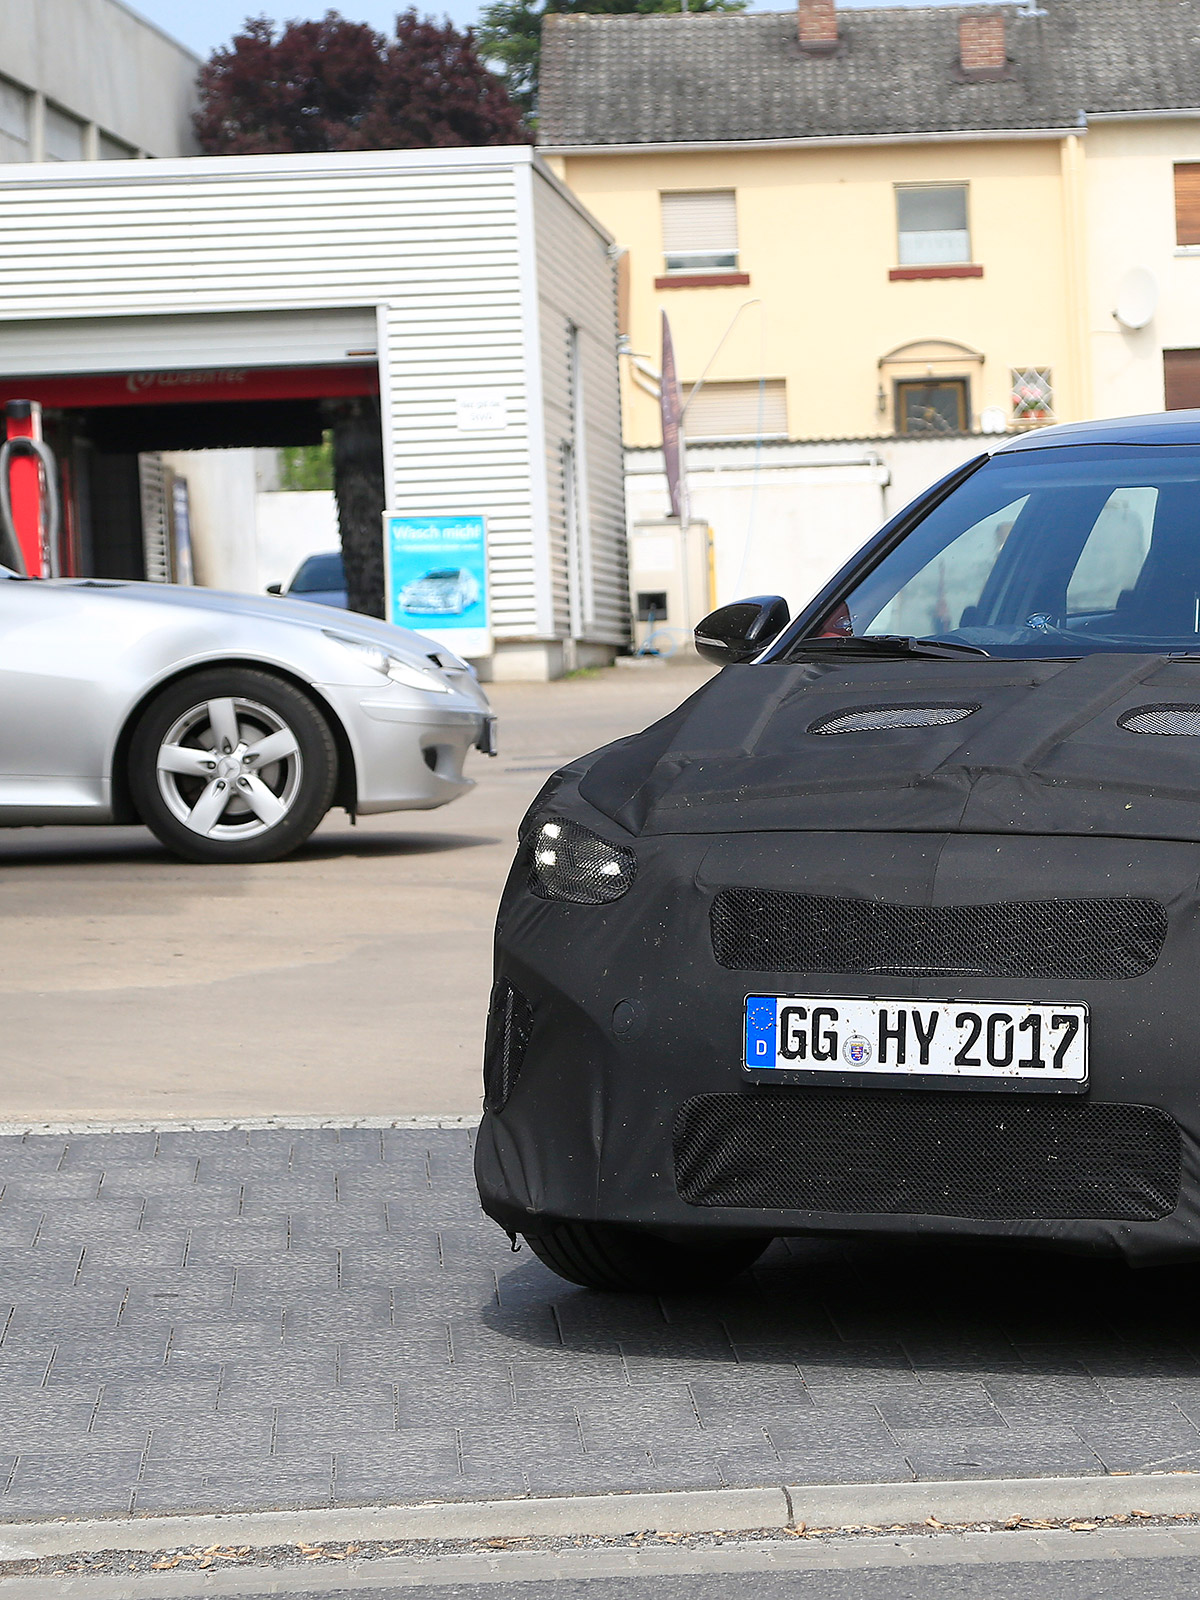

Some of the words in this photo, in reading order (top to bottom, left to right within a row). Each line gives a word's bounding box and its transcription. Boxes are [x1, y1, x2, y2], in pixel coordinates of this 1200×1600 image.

[392, 525, 440, 540] Wasch
[780, 1006, 839, 1062] GG
[877, 1009, 940, 1065] HY
[953, 1012, 1080, 1069] 2017
[755, 1040, 768, 1056] D
